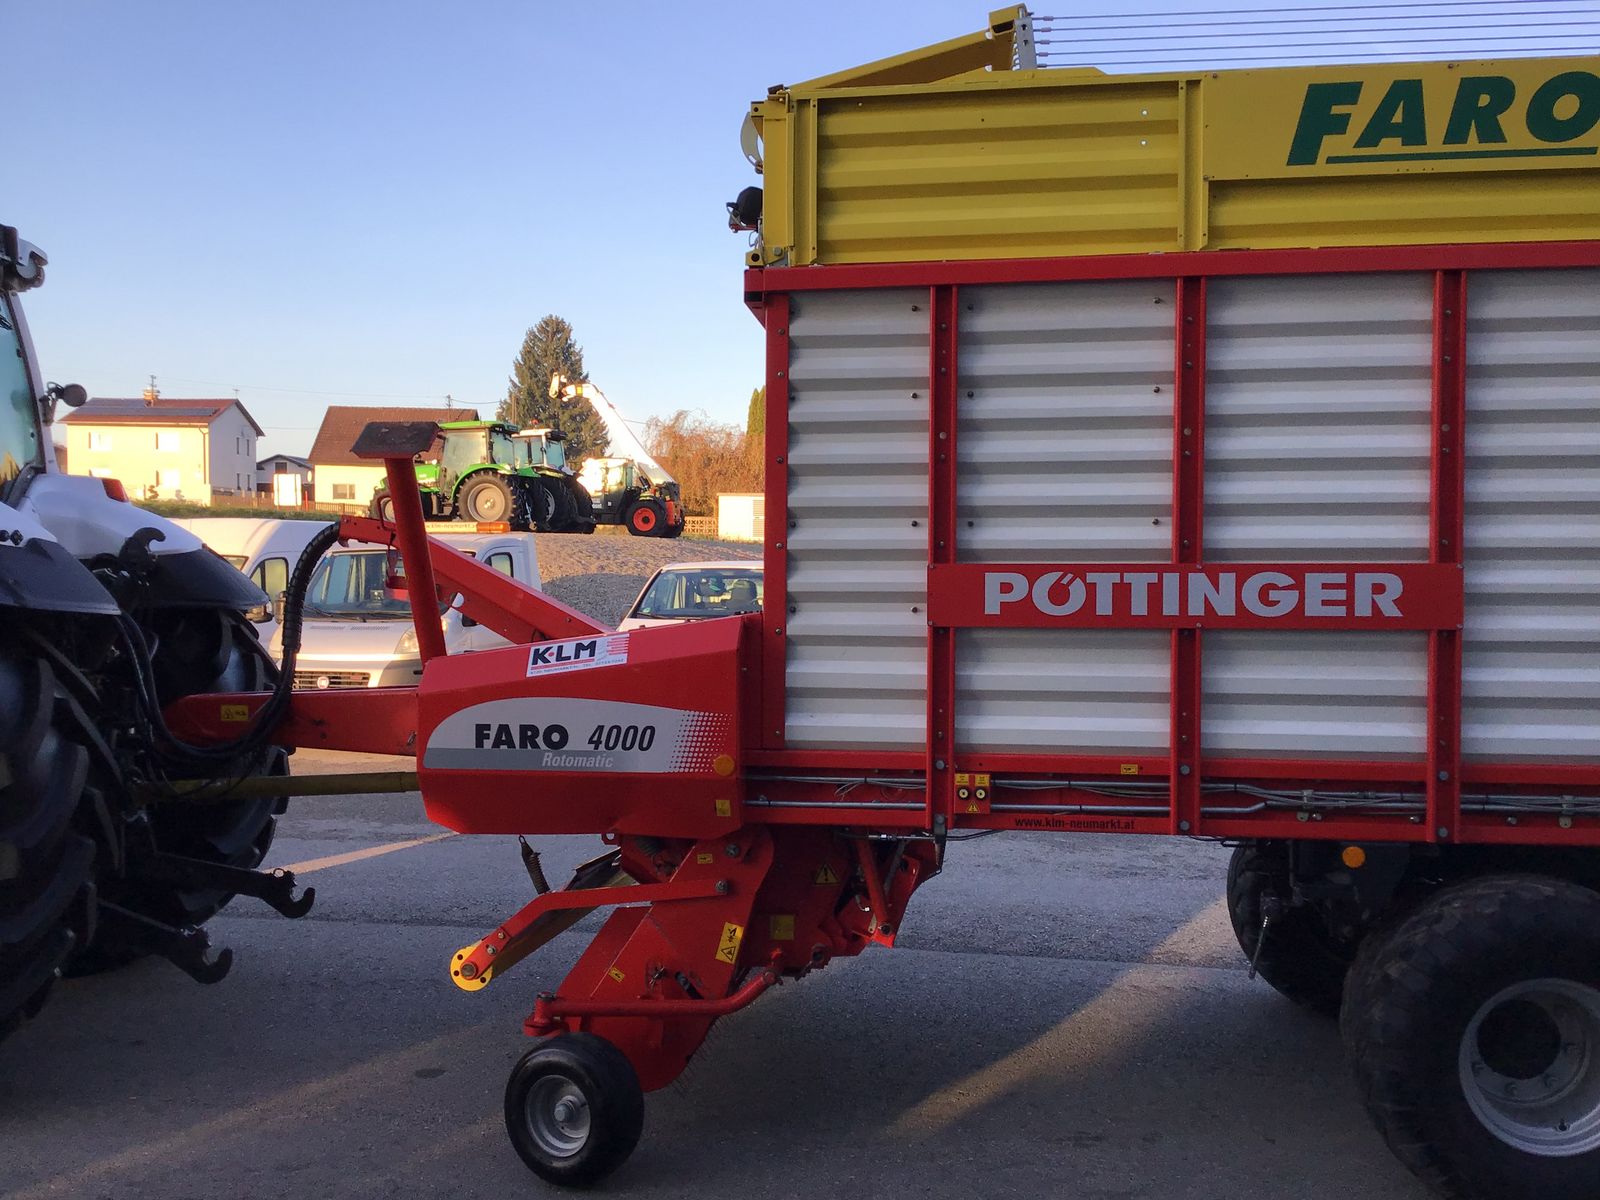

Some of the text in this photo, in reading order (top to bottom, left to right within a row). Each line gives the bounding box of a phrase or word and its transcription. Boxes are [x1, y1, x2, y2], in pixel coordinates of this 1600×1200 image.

[1286, 71, 1600, 166] FARO
[984, 571, 1404, 618] PÖTTINGER
[474, 723, 656, 752] FARO 4000
[541, 752, 614, 768] Rotomatic
